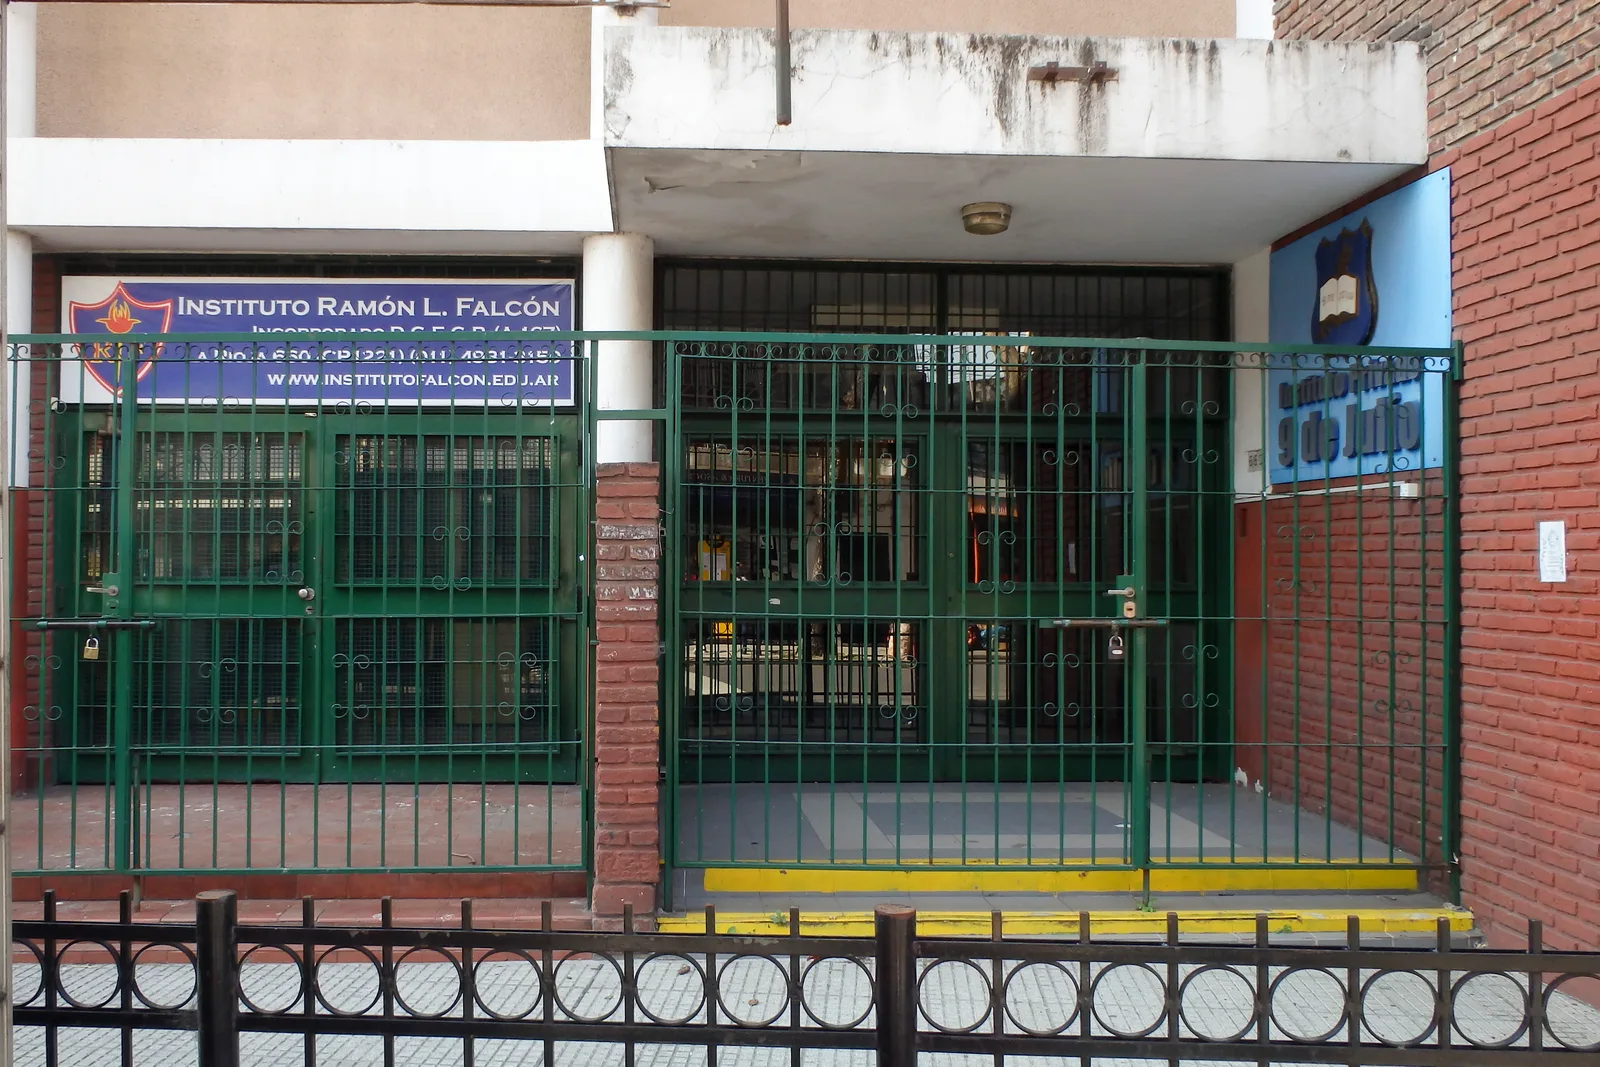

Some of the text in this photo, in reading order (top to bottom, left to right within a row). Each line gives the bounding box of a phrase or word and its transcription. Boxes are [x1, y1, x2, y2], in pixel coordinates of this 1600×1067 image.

[178, 295, 560, 316] INSTITUTO RAMÓN L. FALCÓN
[1278, 393, 1421, 467] 9 de Julio
